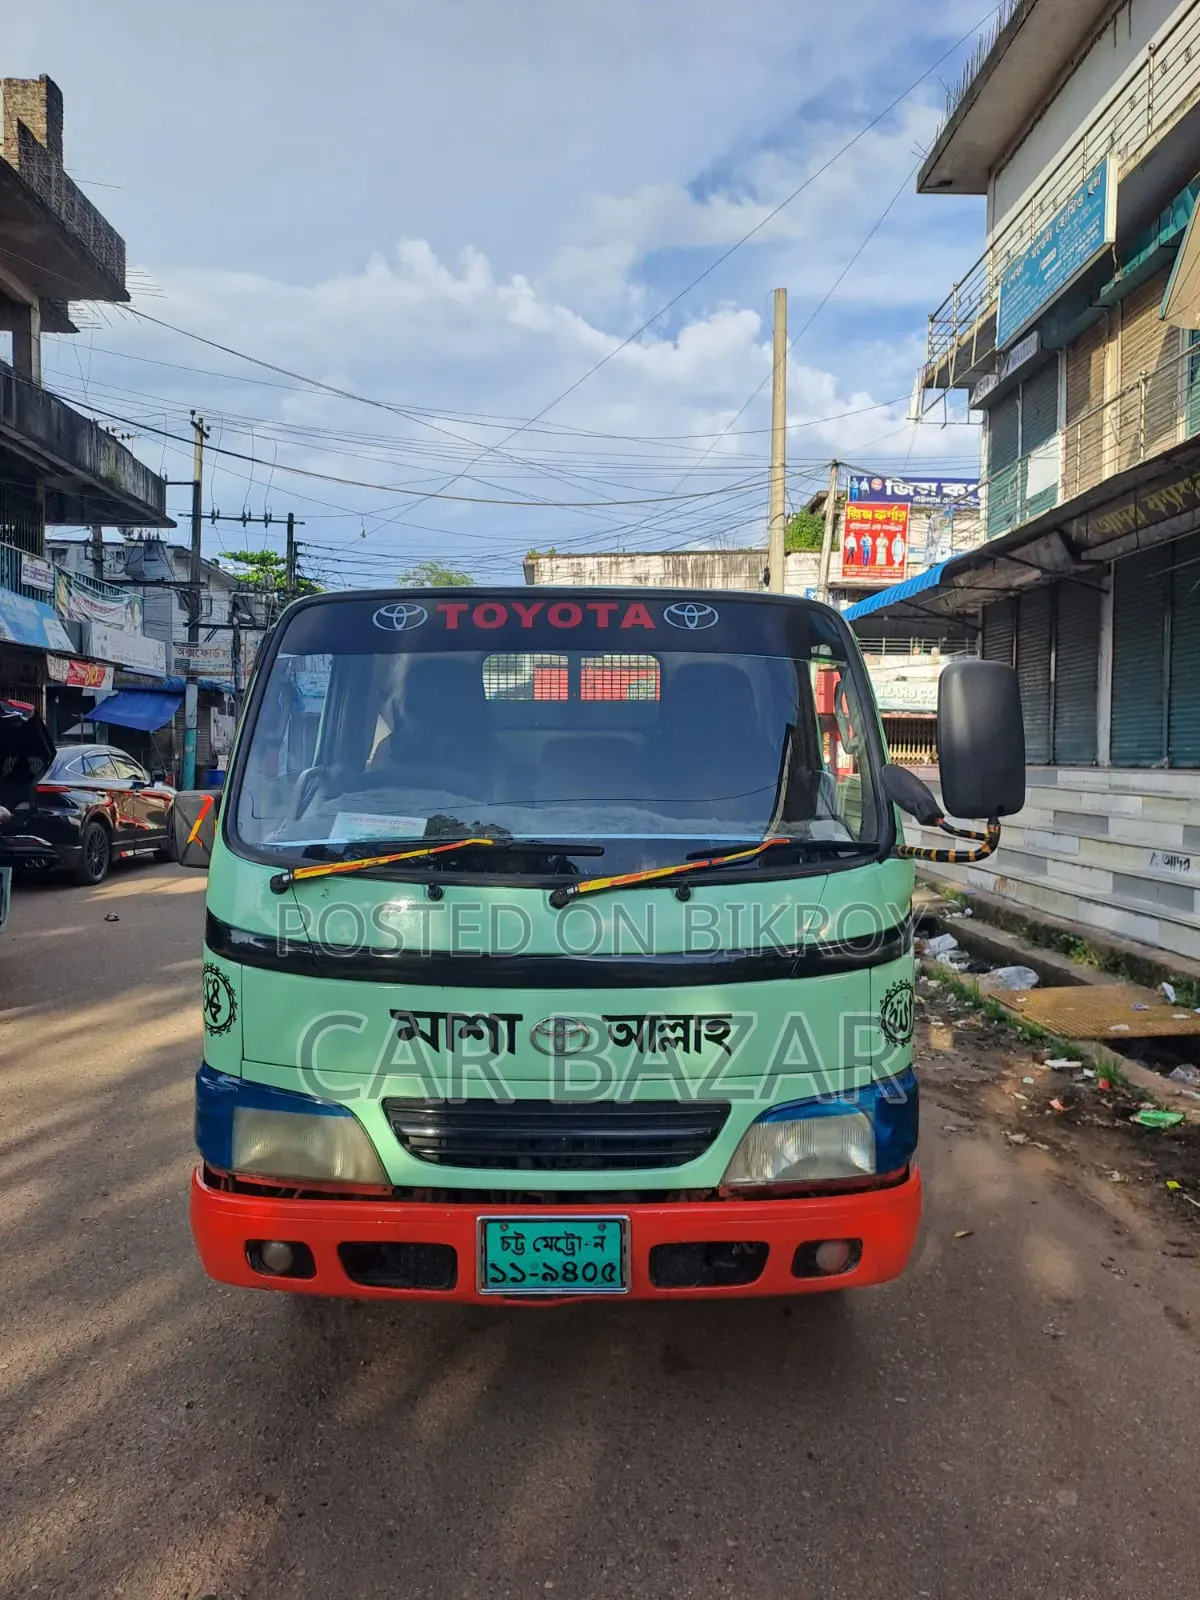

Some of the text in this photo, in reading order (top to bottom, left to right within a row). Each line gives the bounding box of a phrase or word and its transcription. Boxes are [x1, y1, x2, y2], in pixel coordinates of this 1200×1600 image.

[437, 603, 656, 630] TOYOTA
[389, 1009, 733, 1056] মাশা আল্লাহ
[489, 1261, 617, 1283] ১১-৯৪০৫
